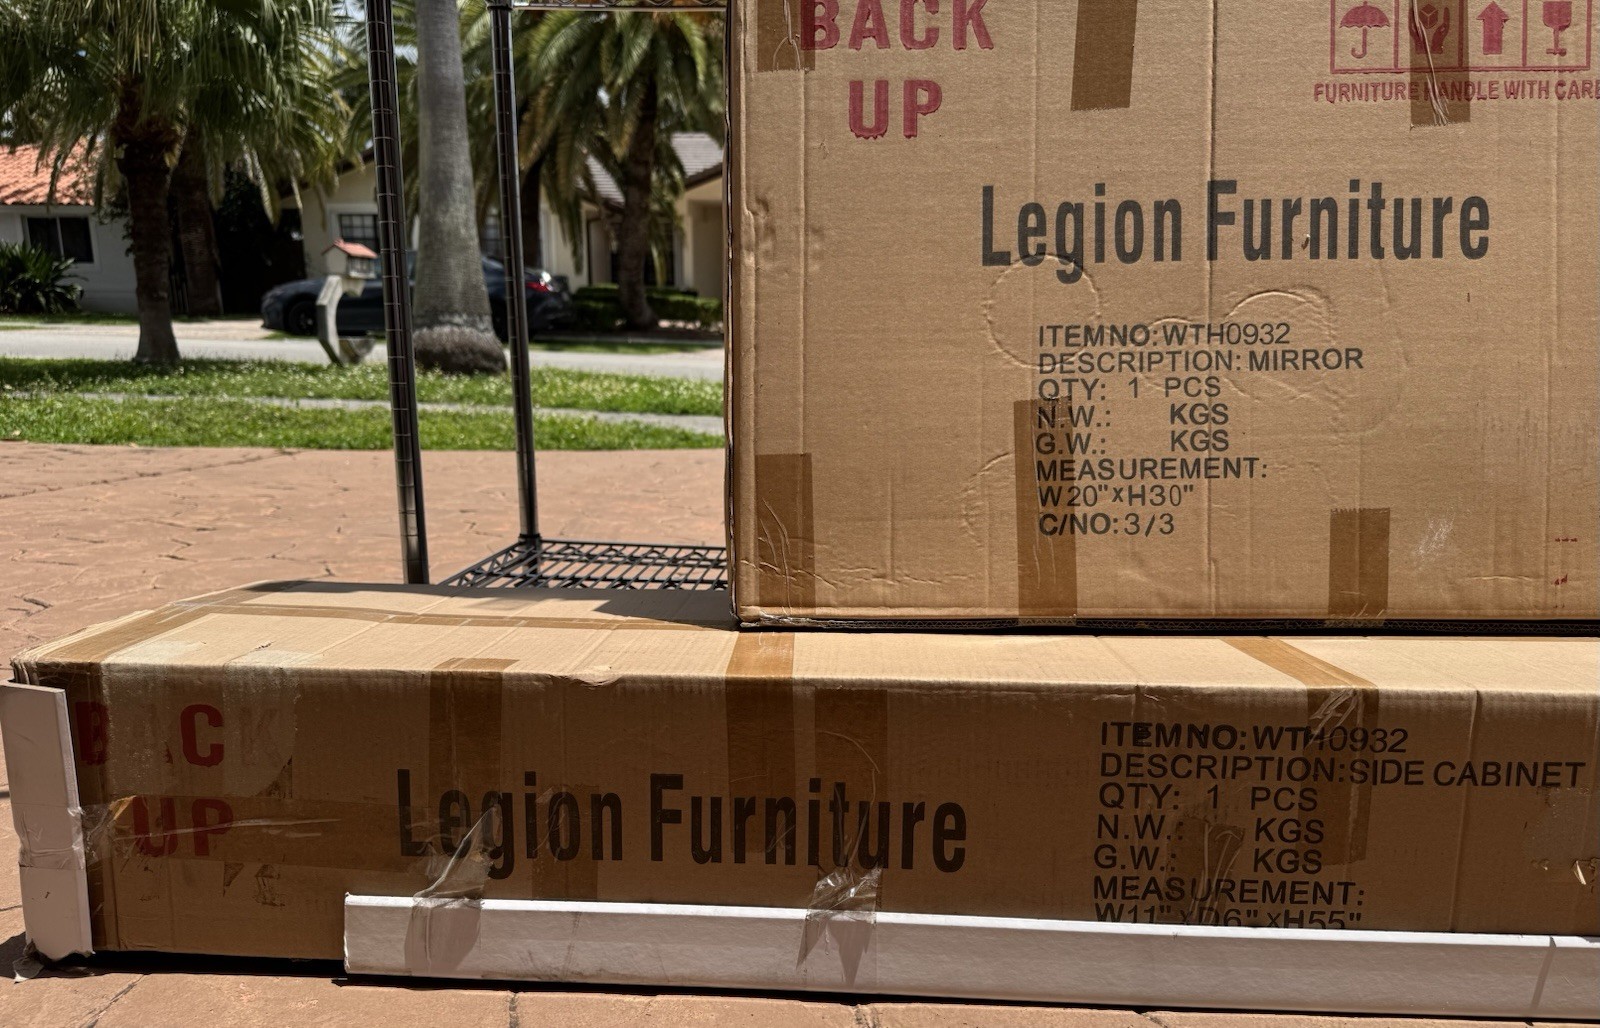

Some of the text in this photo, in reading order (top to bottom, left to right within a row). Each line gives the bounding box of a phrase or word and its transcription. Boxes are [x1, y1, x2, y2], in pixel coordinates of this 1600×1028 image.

[800, 0, 995, 50] BACK
[1313, 80, 1419, 104] FURNITURE
[1424, 79, 1500, 101] HANDLE
[1504, 79, 1550, 100] WITH
[849, 79, 943, 140] UP
[981, 178, 1491, 284] Legion Furniture
[1248, 347, 1365, 372] MIRROR
[1038, 376, 1222, 400] QTY: 1 PCS
[1037, 402, 1230, 429] N.W.: KGS
[1035, 430, 1231, 456] G.W.: KGS
[1036, 457, 1268, 482] MEASUREMENT:
[1433, 760, 1587, 788] CABINET
[1099, 782, 1319, 812] QTY: 1 PCS
[132, 798, 234, 858] UP
[397, 768, 967, 880] Legion Furniture
[1096, 813, 1325, 844] N.W.: KGS
[1093, 843, 1323, 875] G.W.: KGS
[1092, 875, 1366, 907] MEASUREMENT:
